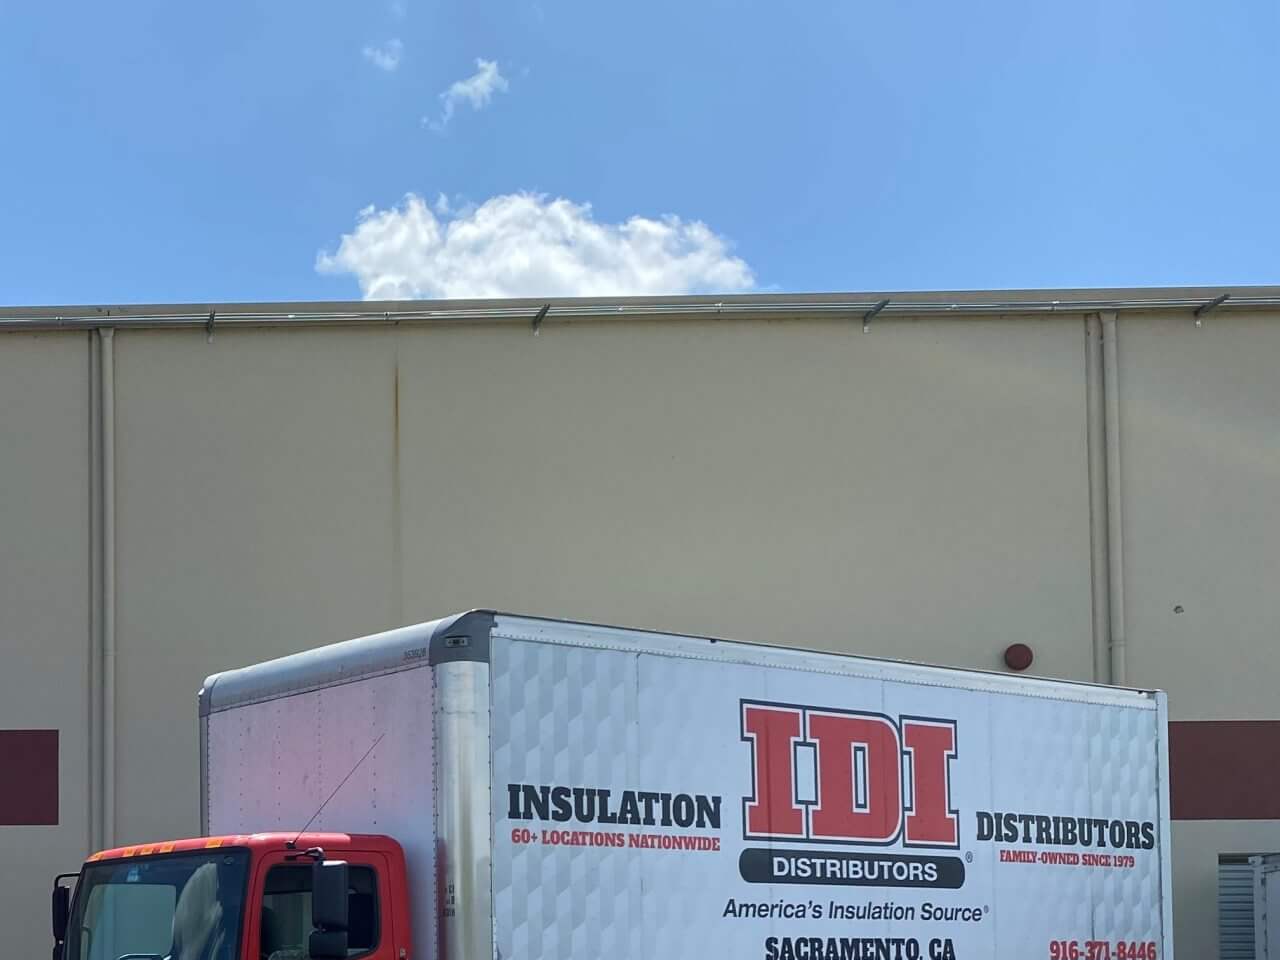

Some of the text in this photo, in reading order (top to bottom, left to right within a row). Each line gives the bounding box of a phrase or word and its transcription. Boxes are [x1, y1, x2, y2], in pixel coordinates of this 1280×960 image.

[739, 698, 960, 850] IDI
[507, 784, 722, 829] INSULATION
[511, 829, 721, 852] 60+ LOCATIONS NATIONWIDE
[976, 811, 1155, 850] DISTRIBUTORS
[773, 857, 938, 882] DISTRIBUTORS
[1000, 849, 1135, 868] FAMILY-OWNED SINCE 1979
[723, 899, 823, 919] America's
[829, 901, 915, 921] Insulation
[1050, 941, 1157, 960] 916-371-8446
